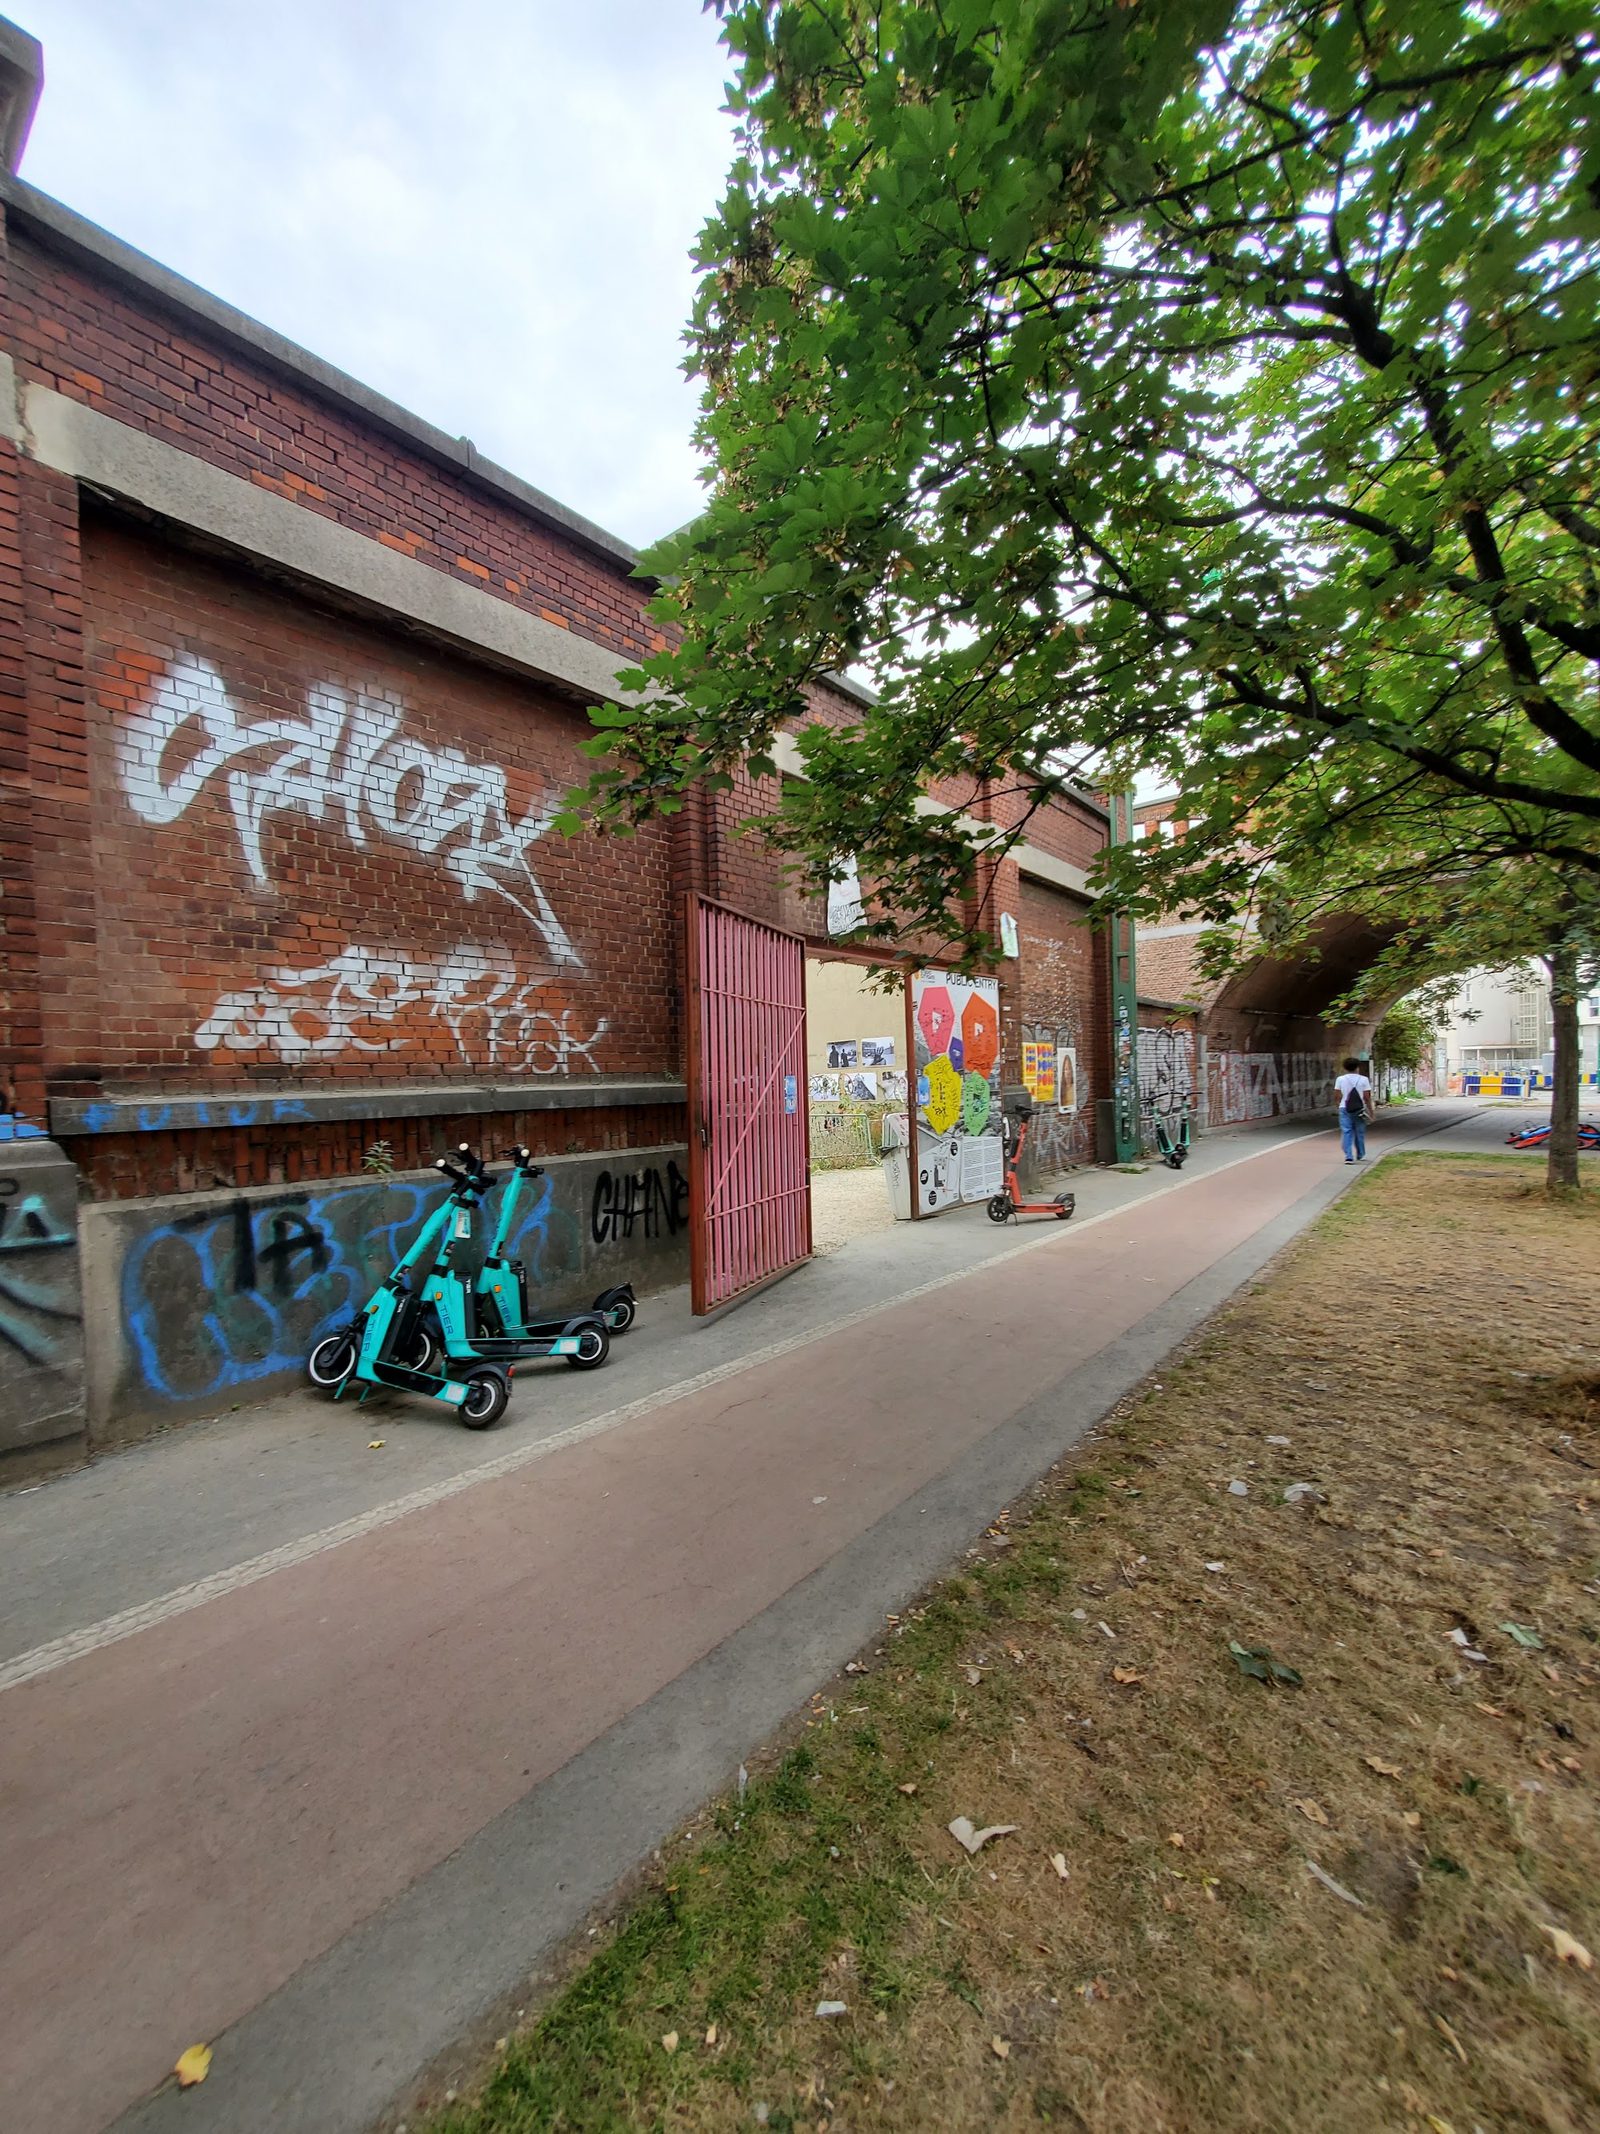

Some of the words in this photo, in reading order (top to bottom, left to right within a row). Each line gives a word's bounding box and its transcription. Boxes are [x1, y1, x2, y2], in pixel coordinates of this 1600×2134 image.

[975, 977, 998, 990] ENTRY
[440, 1304, 454, 1335] TIER
[498, 1296, 512, 1324] TIER
[363, 1320, 377, 1352] TIER
